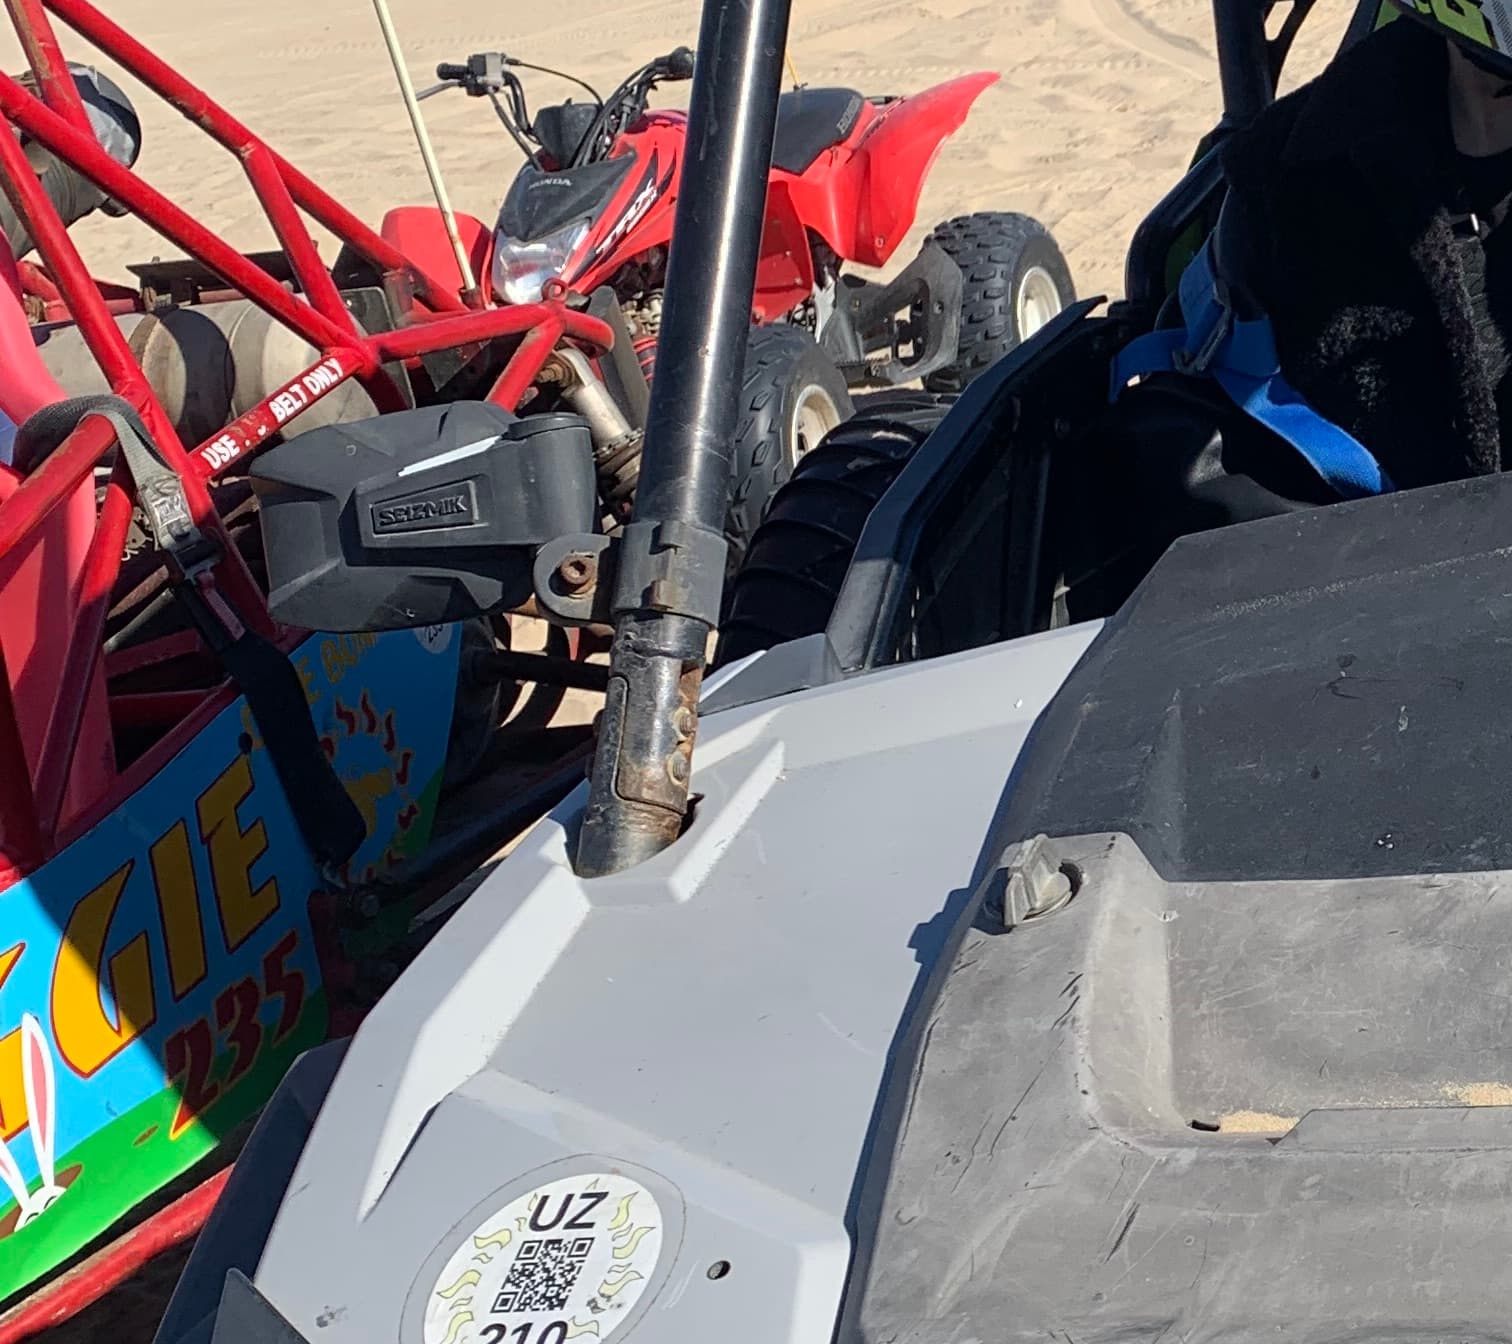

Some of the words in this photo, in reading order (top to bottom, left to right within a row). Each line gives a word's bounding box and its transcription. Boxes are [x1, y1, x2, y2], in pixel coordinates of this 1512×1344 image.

[200, 434, 240, 470] USE
[268, 383, 308, 423] BELT
[302, 357, 344, 396] ONLY
[379, 495, 468, 526] SEIZMIK
[164, 928, 305, 1140] 235
[528, 1191, 610, 1233] UZ
